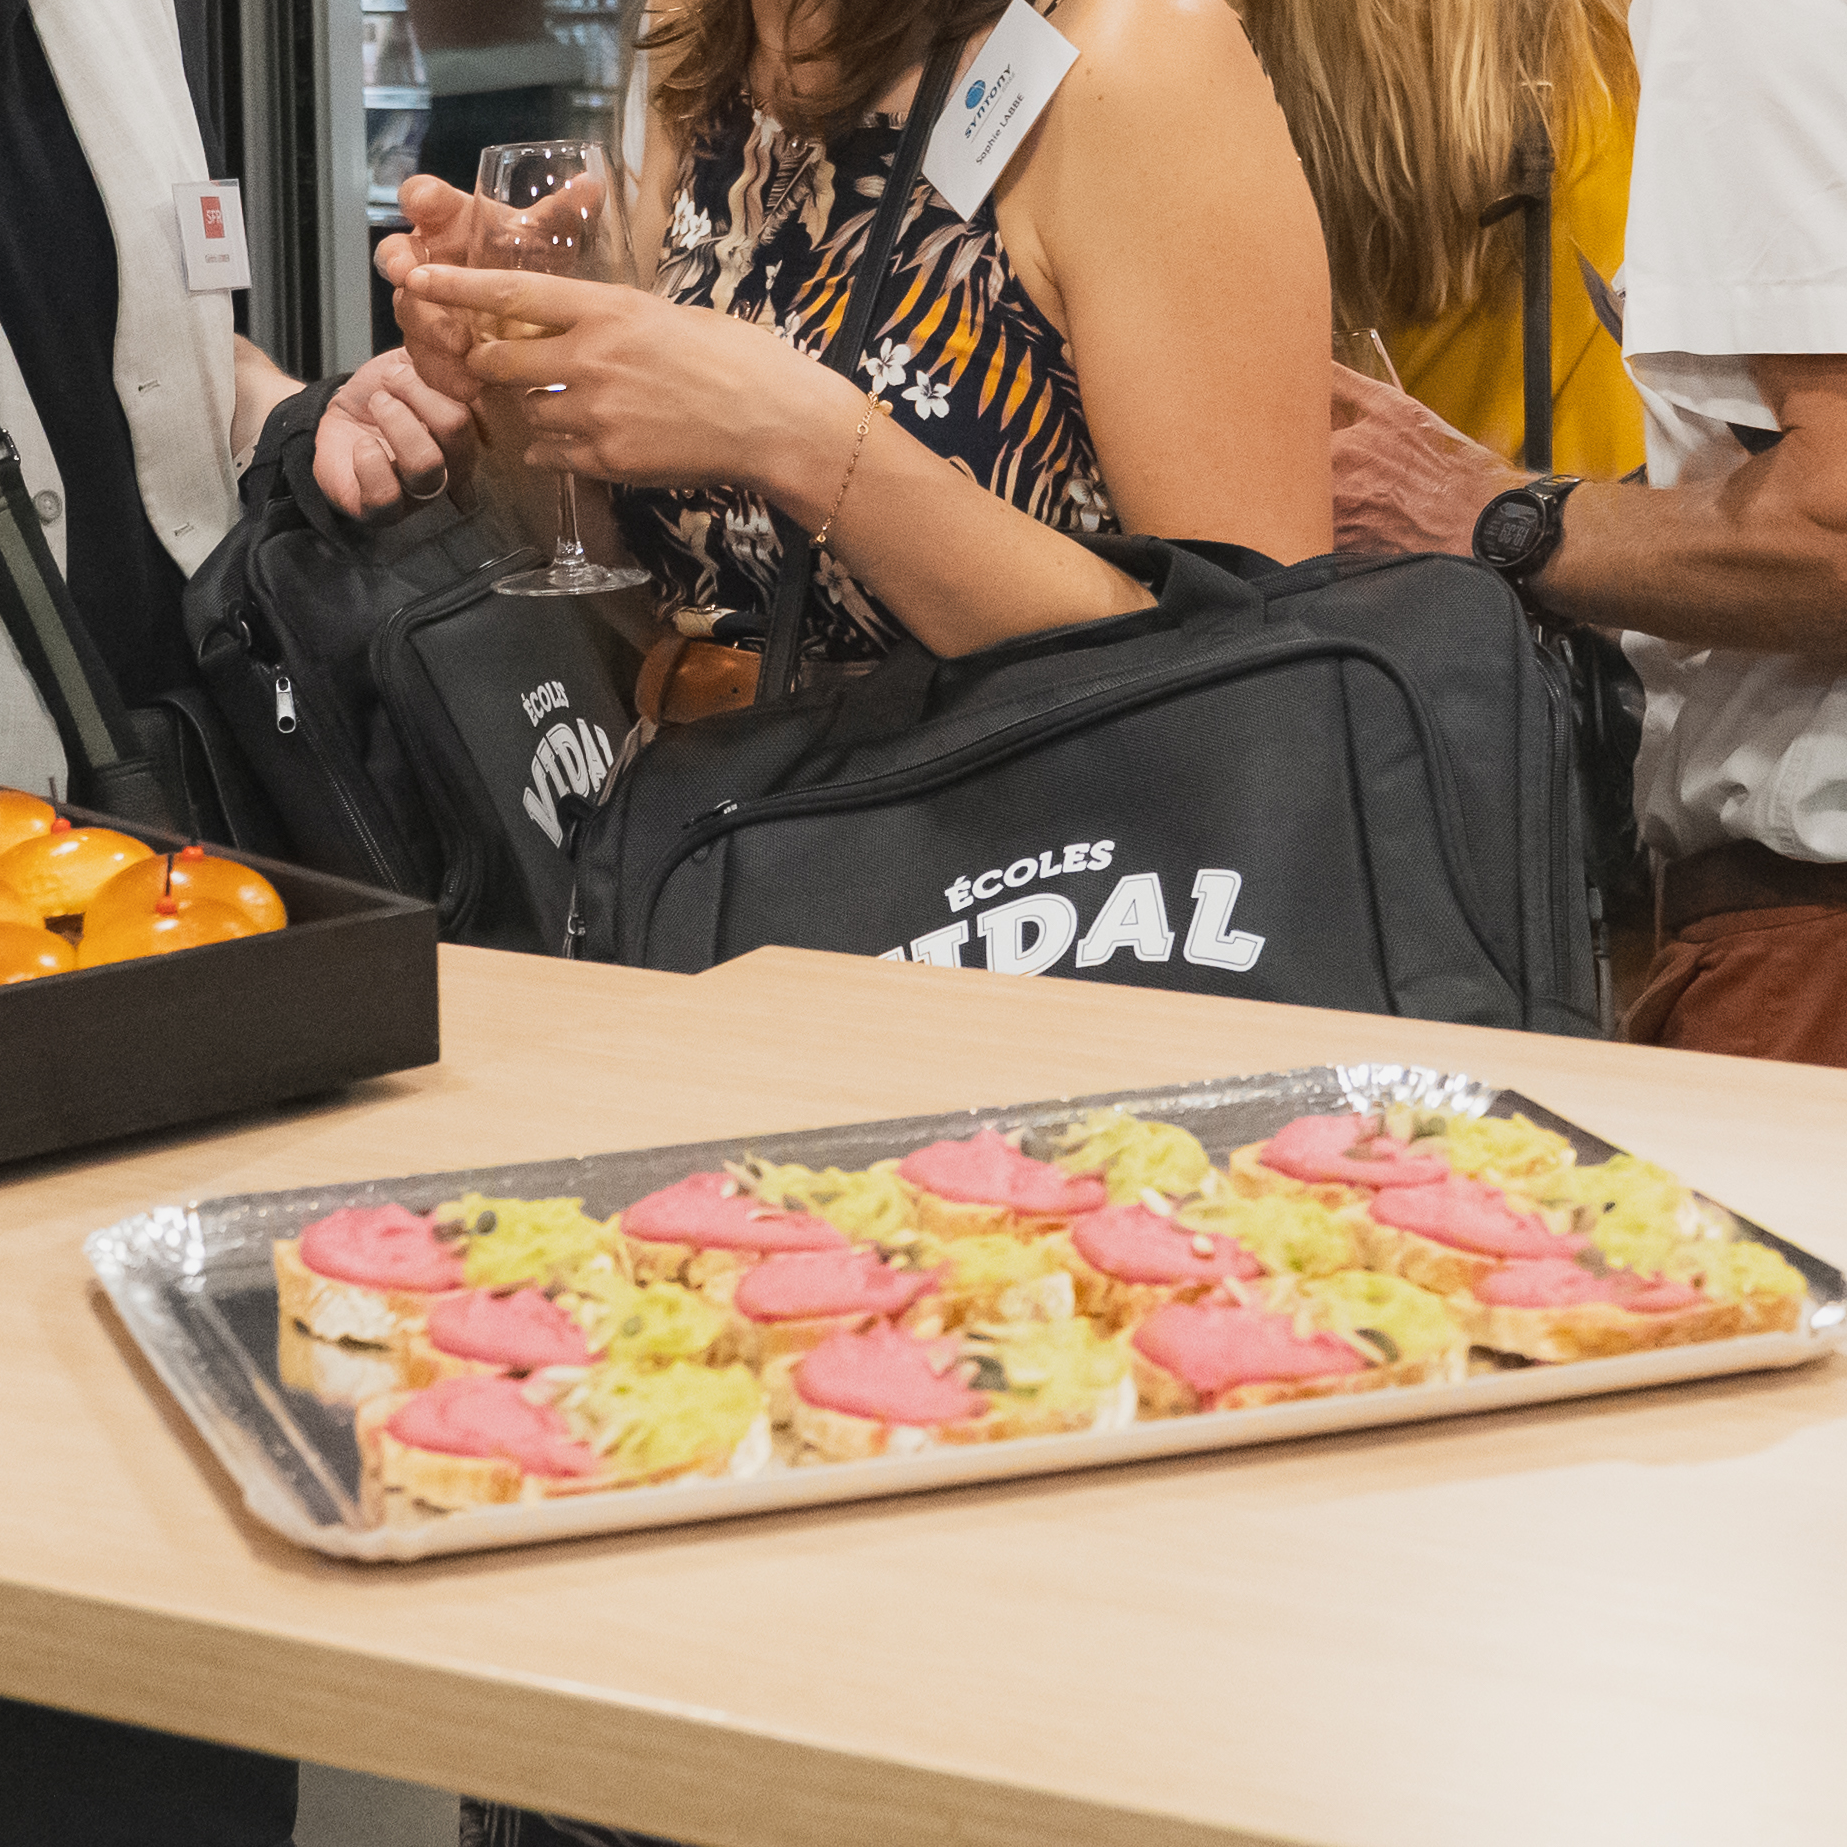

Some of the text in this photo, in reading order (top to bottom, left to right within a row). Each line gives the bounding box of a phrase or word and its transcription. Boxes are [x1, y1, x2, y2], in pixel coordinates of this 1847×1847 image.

[976, 129, 1002, 165] Sophie
[520, 680, 570, 728] ÉCOLES
[944, 839, 1116, 913] ÉCOLES
[878, 868, 1266, 978] IDAL
